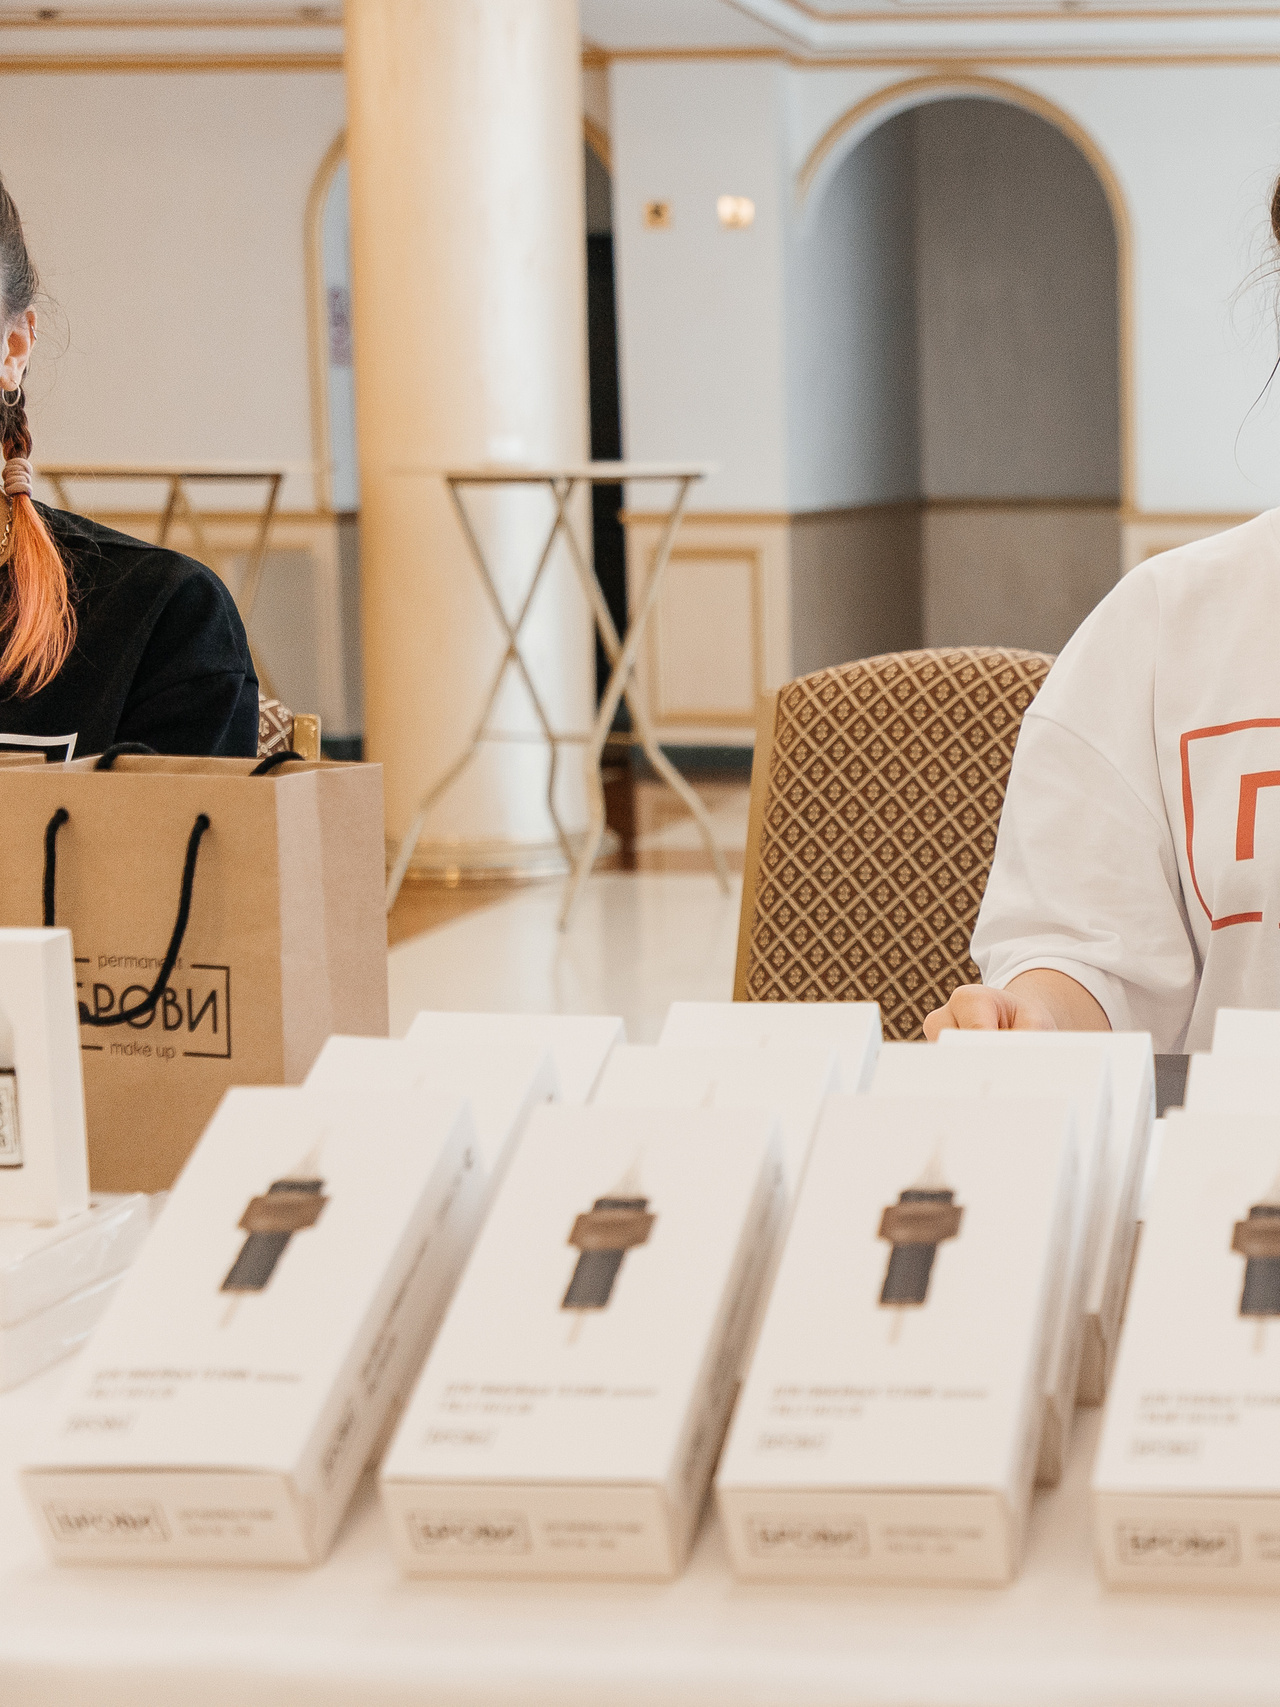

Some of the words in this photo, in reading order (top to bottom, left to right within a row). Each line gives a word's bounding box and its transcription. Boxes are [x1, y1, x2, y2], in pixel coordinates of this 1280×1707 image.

[77, 983, 217, 1034] РОВИ
[110, 1041, 151, 1057] make
[156, 1045, 176, 1061] up
